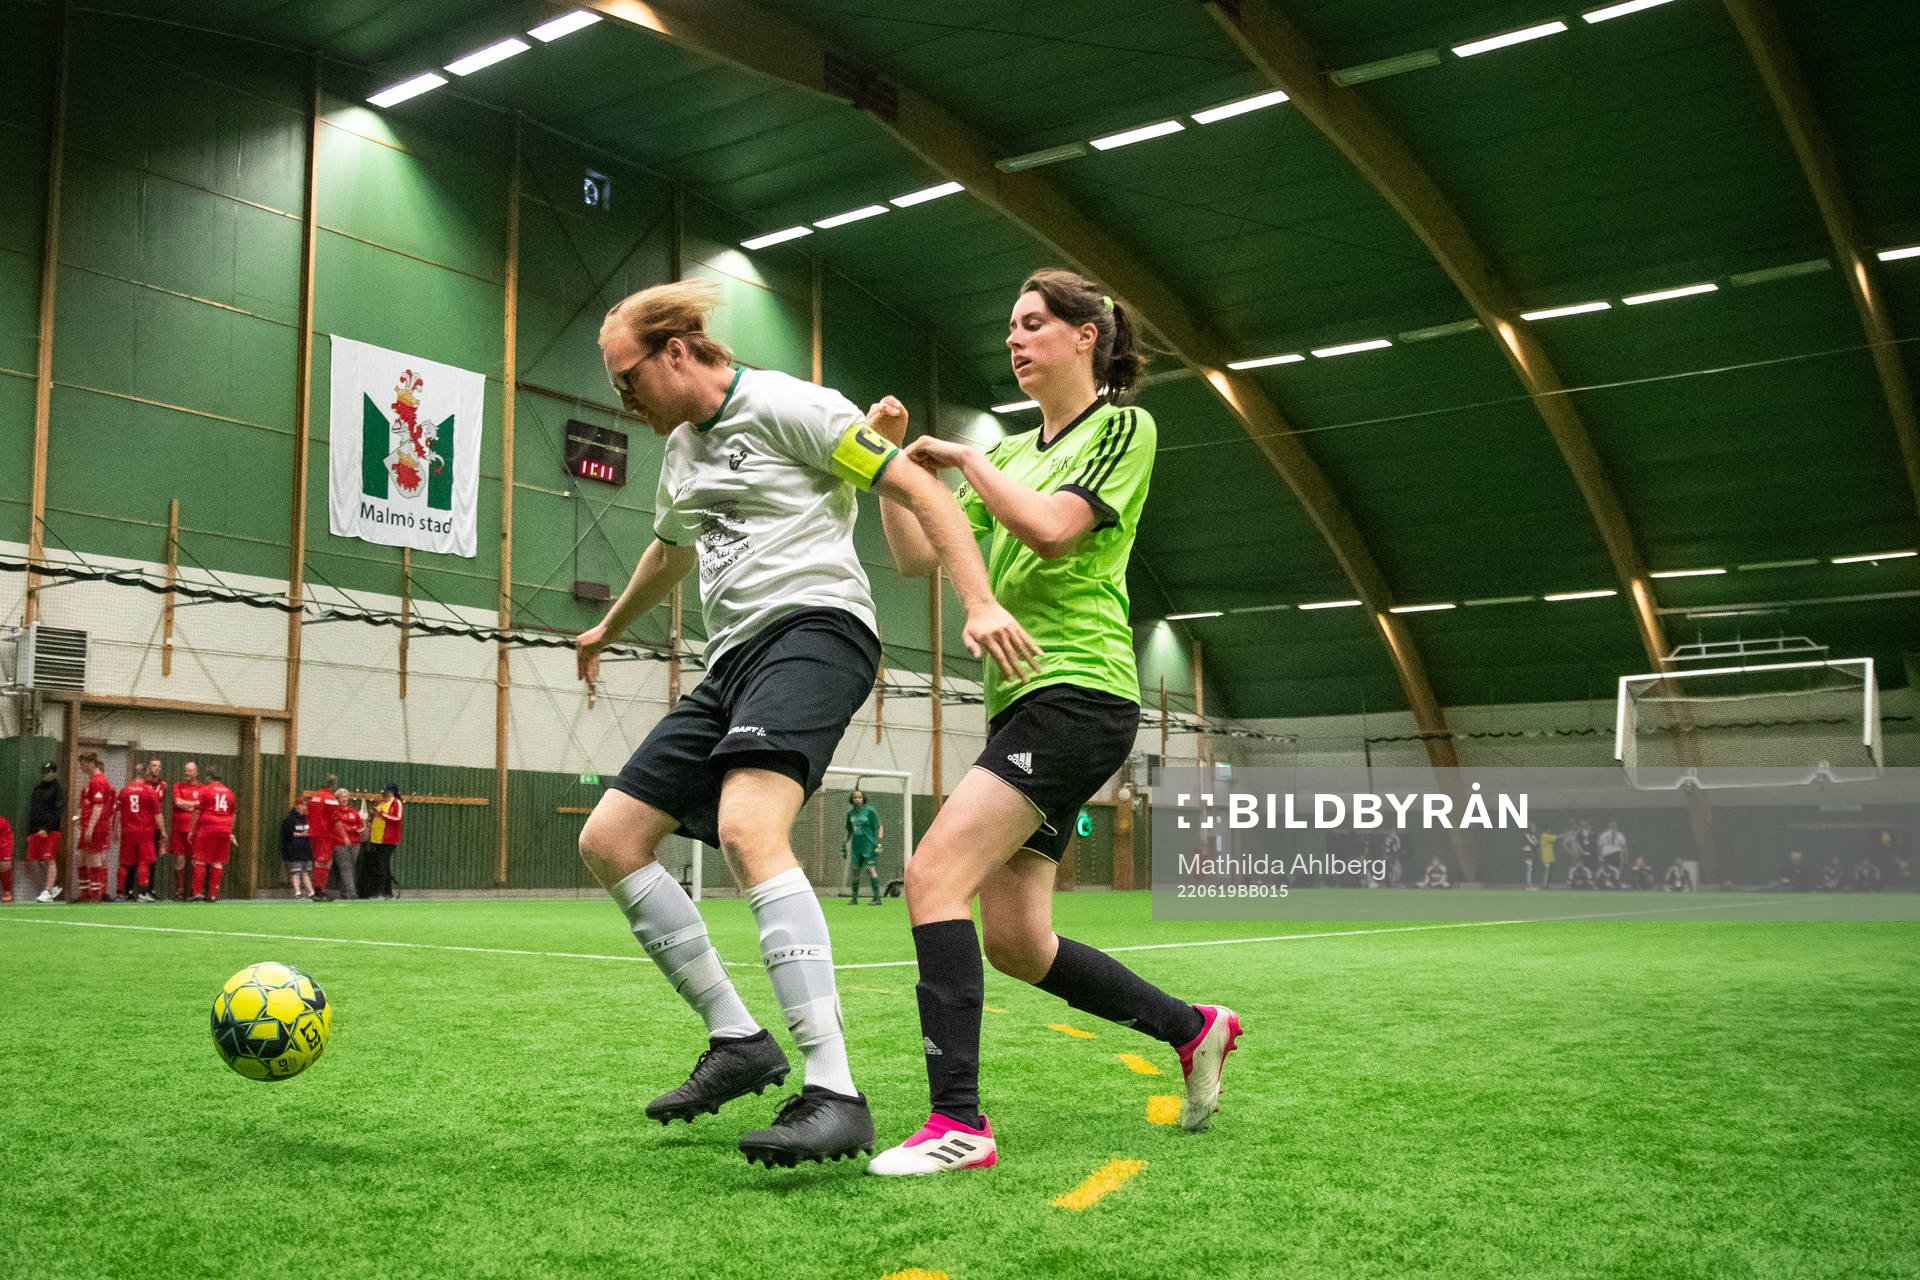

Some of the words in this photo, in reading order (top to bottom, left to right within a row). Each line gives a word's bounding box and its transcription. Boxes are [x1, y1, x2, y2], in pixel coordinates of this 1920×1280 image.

[855, 427, 887, 455] C
[360, 502, 415, 528] Malmö
[419, 517, 453, 534] stad
[1007, 755, 1032, 775] adidas
[129, 794, 140, 813] 8
[215, 793, 228, 812] 14
